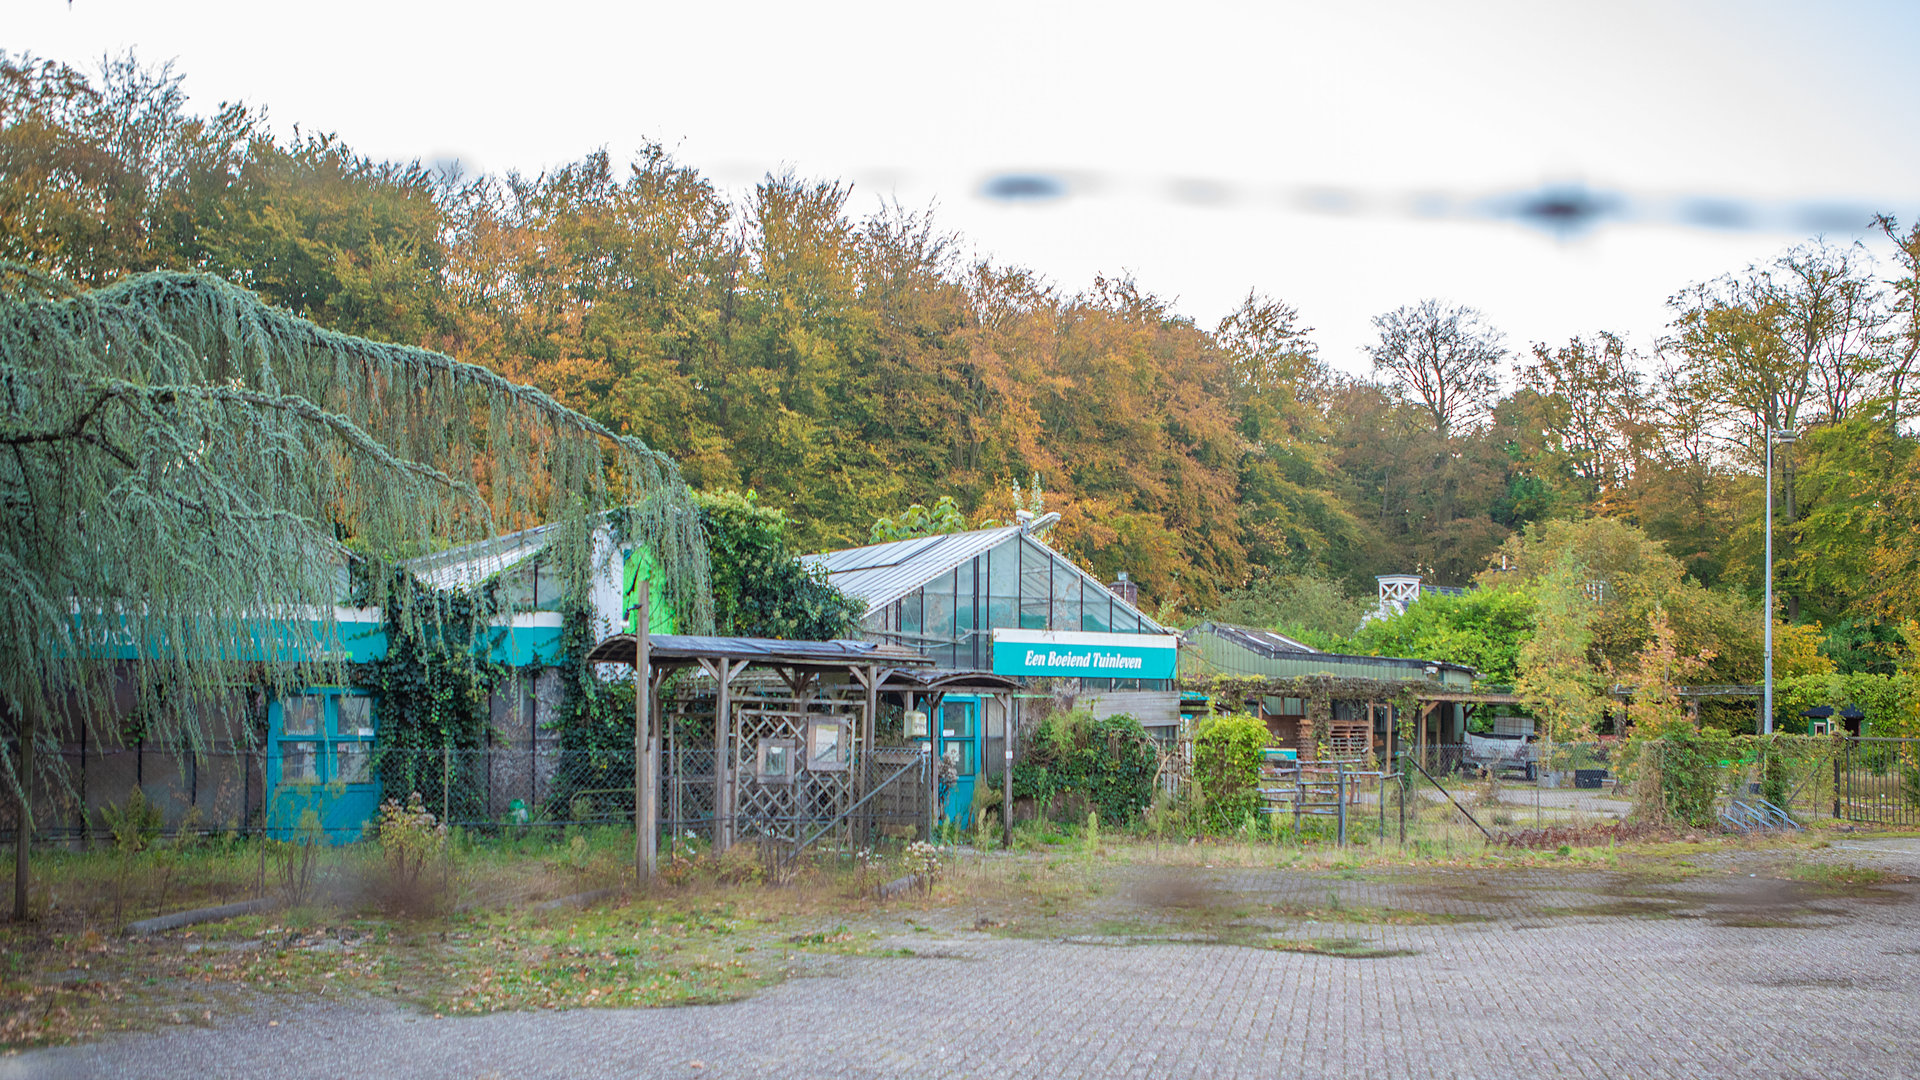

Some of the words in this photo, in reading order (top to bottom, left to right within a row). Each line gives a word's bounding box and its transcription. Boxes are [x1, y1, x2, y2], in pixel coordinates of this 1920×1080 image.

[1025, 650, 1046, 666] Een
[1047, 650, 1091, 668] Boeiend
[1093, 652, 1142, 669] Tuinleven
